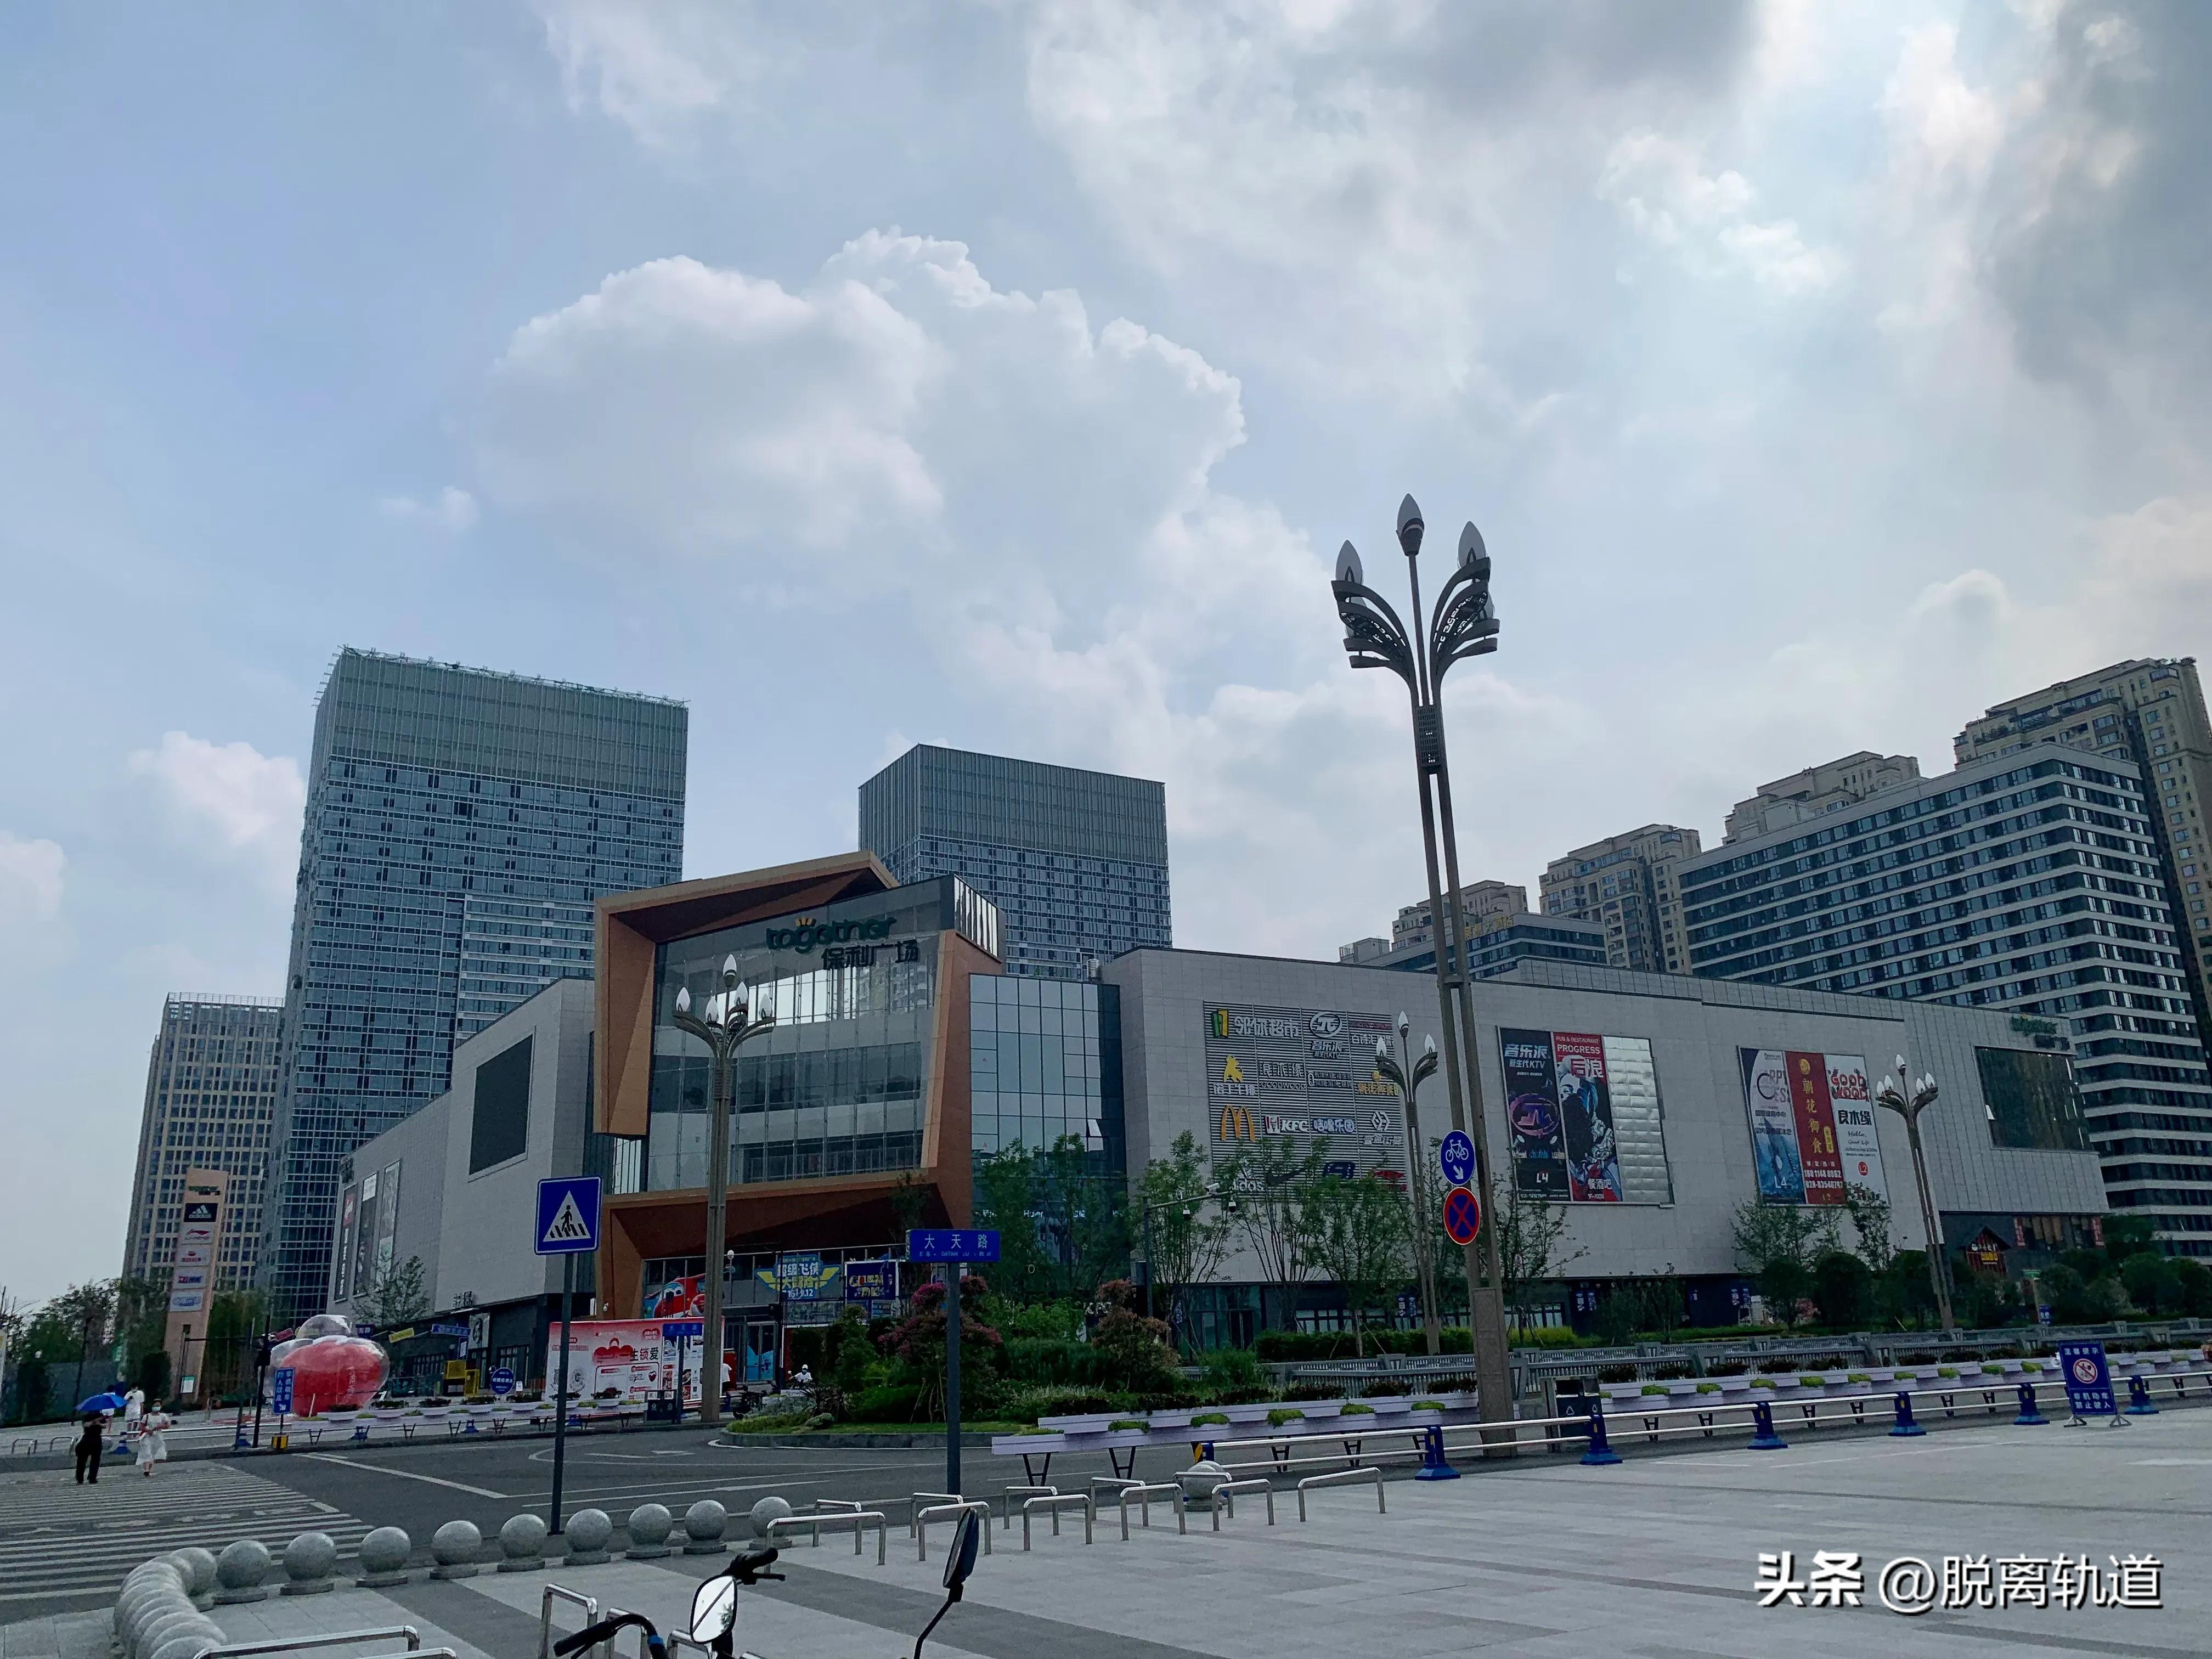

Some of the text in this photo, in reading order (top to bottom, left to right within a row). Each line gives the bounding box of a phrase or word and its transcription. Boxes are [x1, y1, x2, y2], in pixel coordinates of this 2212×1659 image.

[766, 917, 897, 953] together
[821, 939, 919, 970] 保利广场
[1504, 1043, 1548, 1059] 音乐派
[1557, 1044, 1600, 1054] PROGRESS
[1838, 1110, 1872, 1125] 良木缘
[1281, 1120, 1308, 1132] KFC
[1536, 1172, 1548, 1183] L4
[1588, 1178, 1612, 1189] 餐酒吧
[924, 1234, 988, 1249] 大天路
